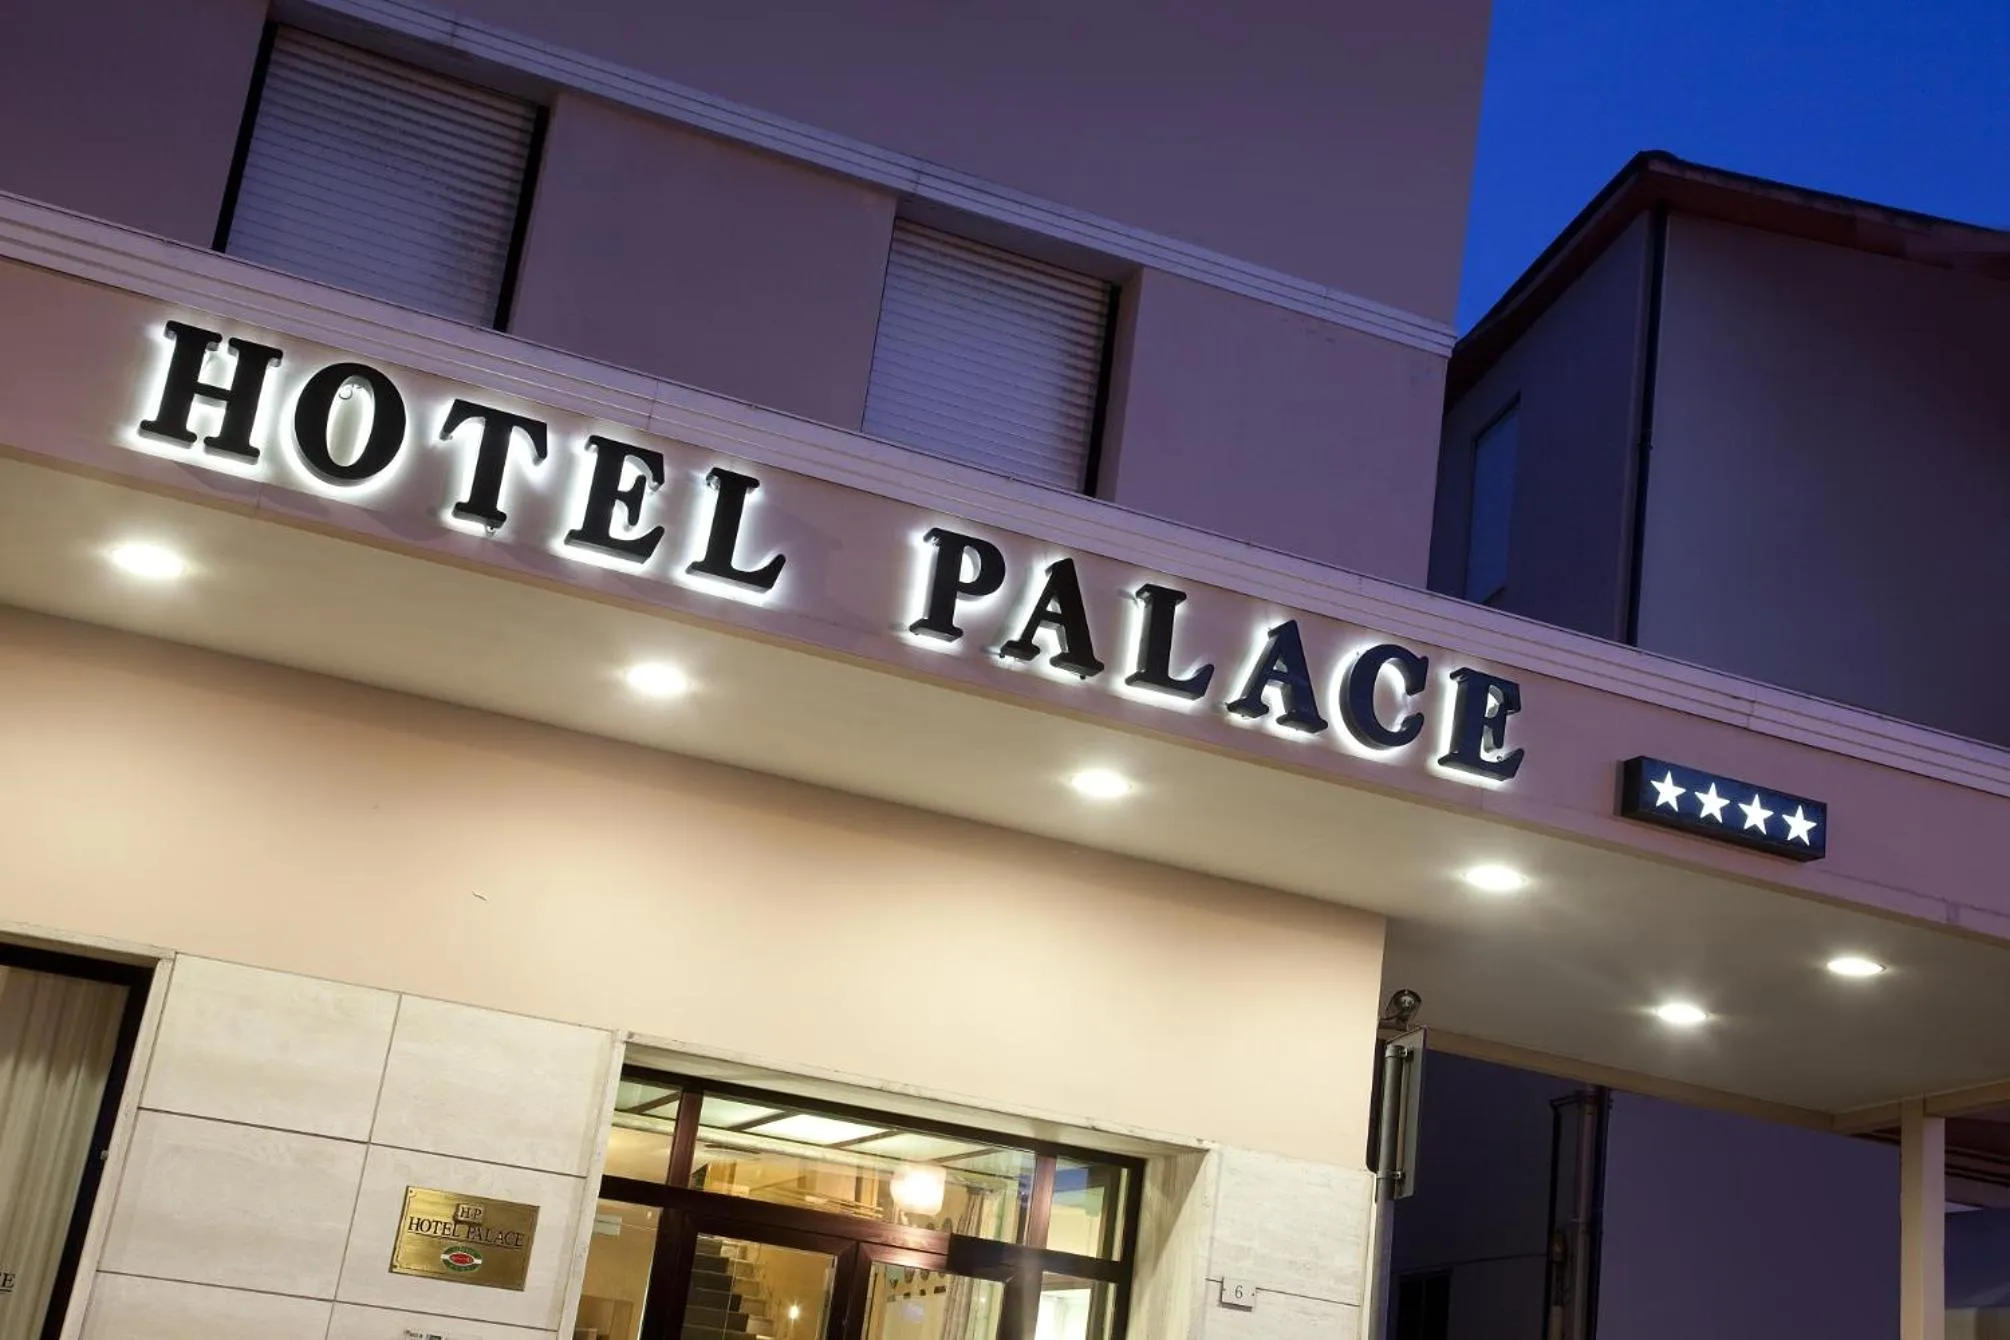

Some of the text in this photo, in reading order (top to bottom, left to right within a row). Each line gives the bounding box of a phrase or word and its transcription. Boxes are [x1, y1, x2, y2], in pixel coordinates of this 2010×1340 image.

[137, 320, 1525, 782] HOTEL PALACE
[407, 1216, 525, 1247] HOTEL PALACE
[1235, 1284, 1243, 1299] 6
